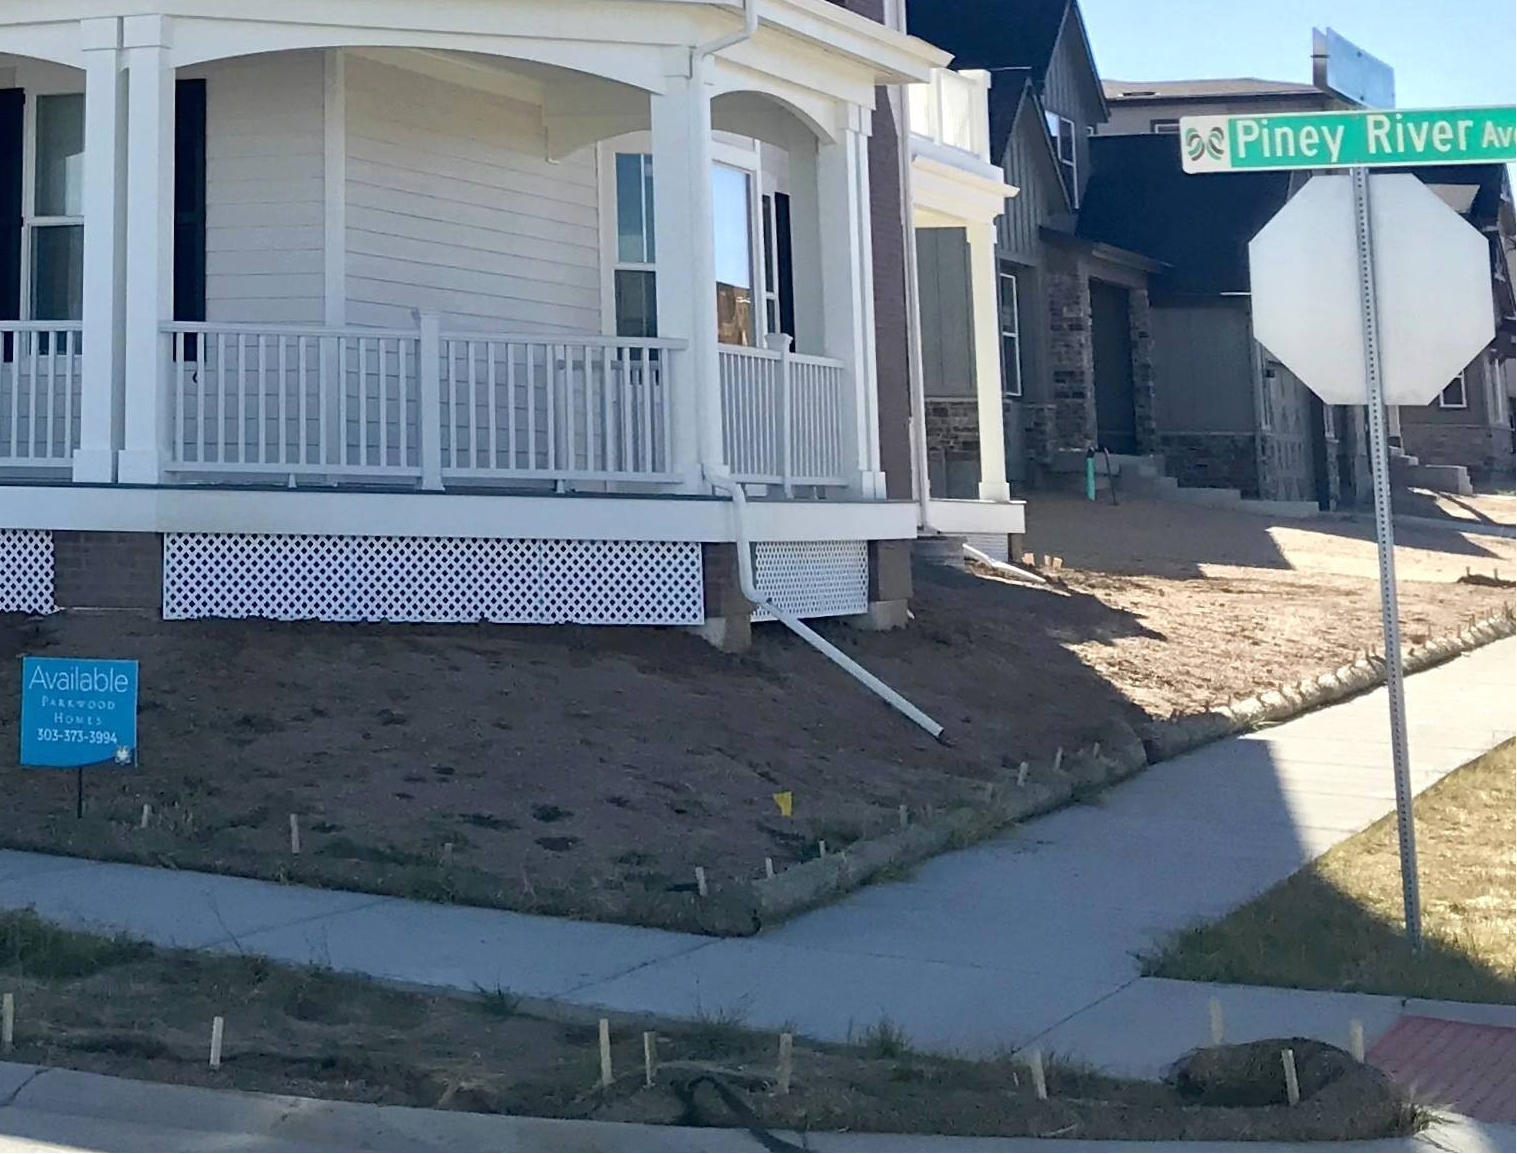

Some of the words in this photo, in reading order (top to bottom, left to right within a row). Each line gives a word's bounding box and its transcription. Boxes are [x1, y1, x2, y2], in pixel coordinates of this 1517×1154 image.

[1235, 118, 1345, 163] Piney
[1366, 113, 1474, 154] River
[1481, 119, 1517, 148] Av
[28, 665, 129, 693] Available
[41, 695, 116, 710] PARKWOOD
[53, 712, 102, 725] HOMES
[36, 728, 118, 745] 303-373-3994
